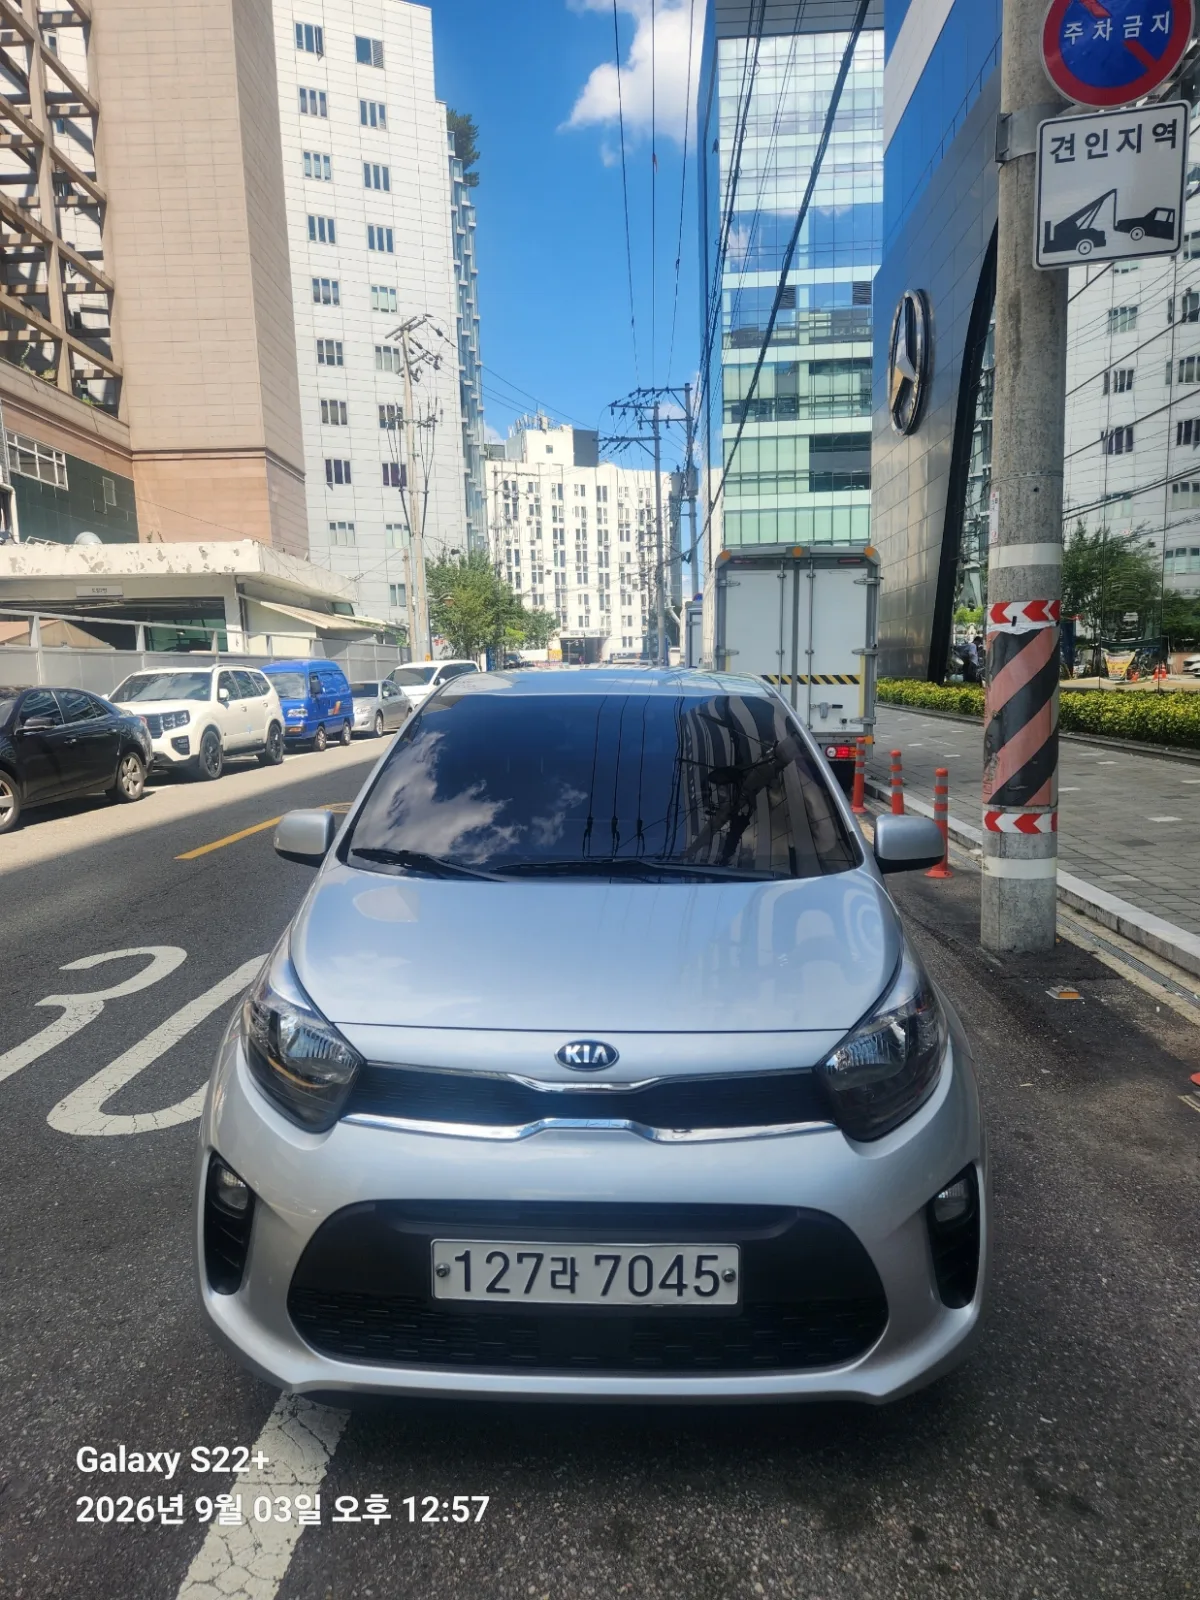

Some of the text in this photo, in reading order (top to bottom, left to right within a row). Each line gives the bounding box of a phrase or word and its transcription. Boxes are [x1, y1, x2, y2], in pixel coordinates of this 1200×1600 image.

[1063, 11, 1170, 46] 주차금지
[1049, 118, 1178, 164] 견인지역
[564, 1045, 610, 1063] KIA
[454, 1249, 721, 1297] 127라 7045
